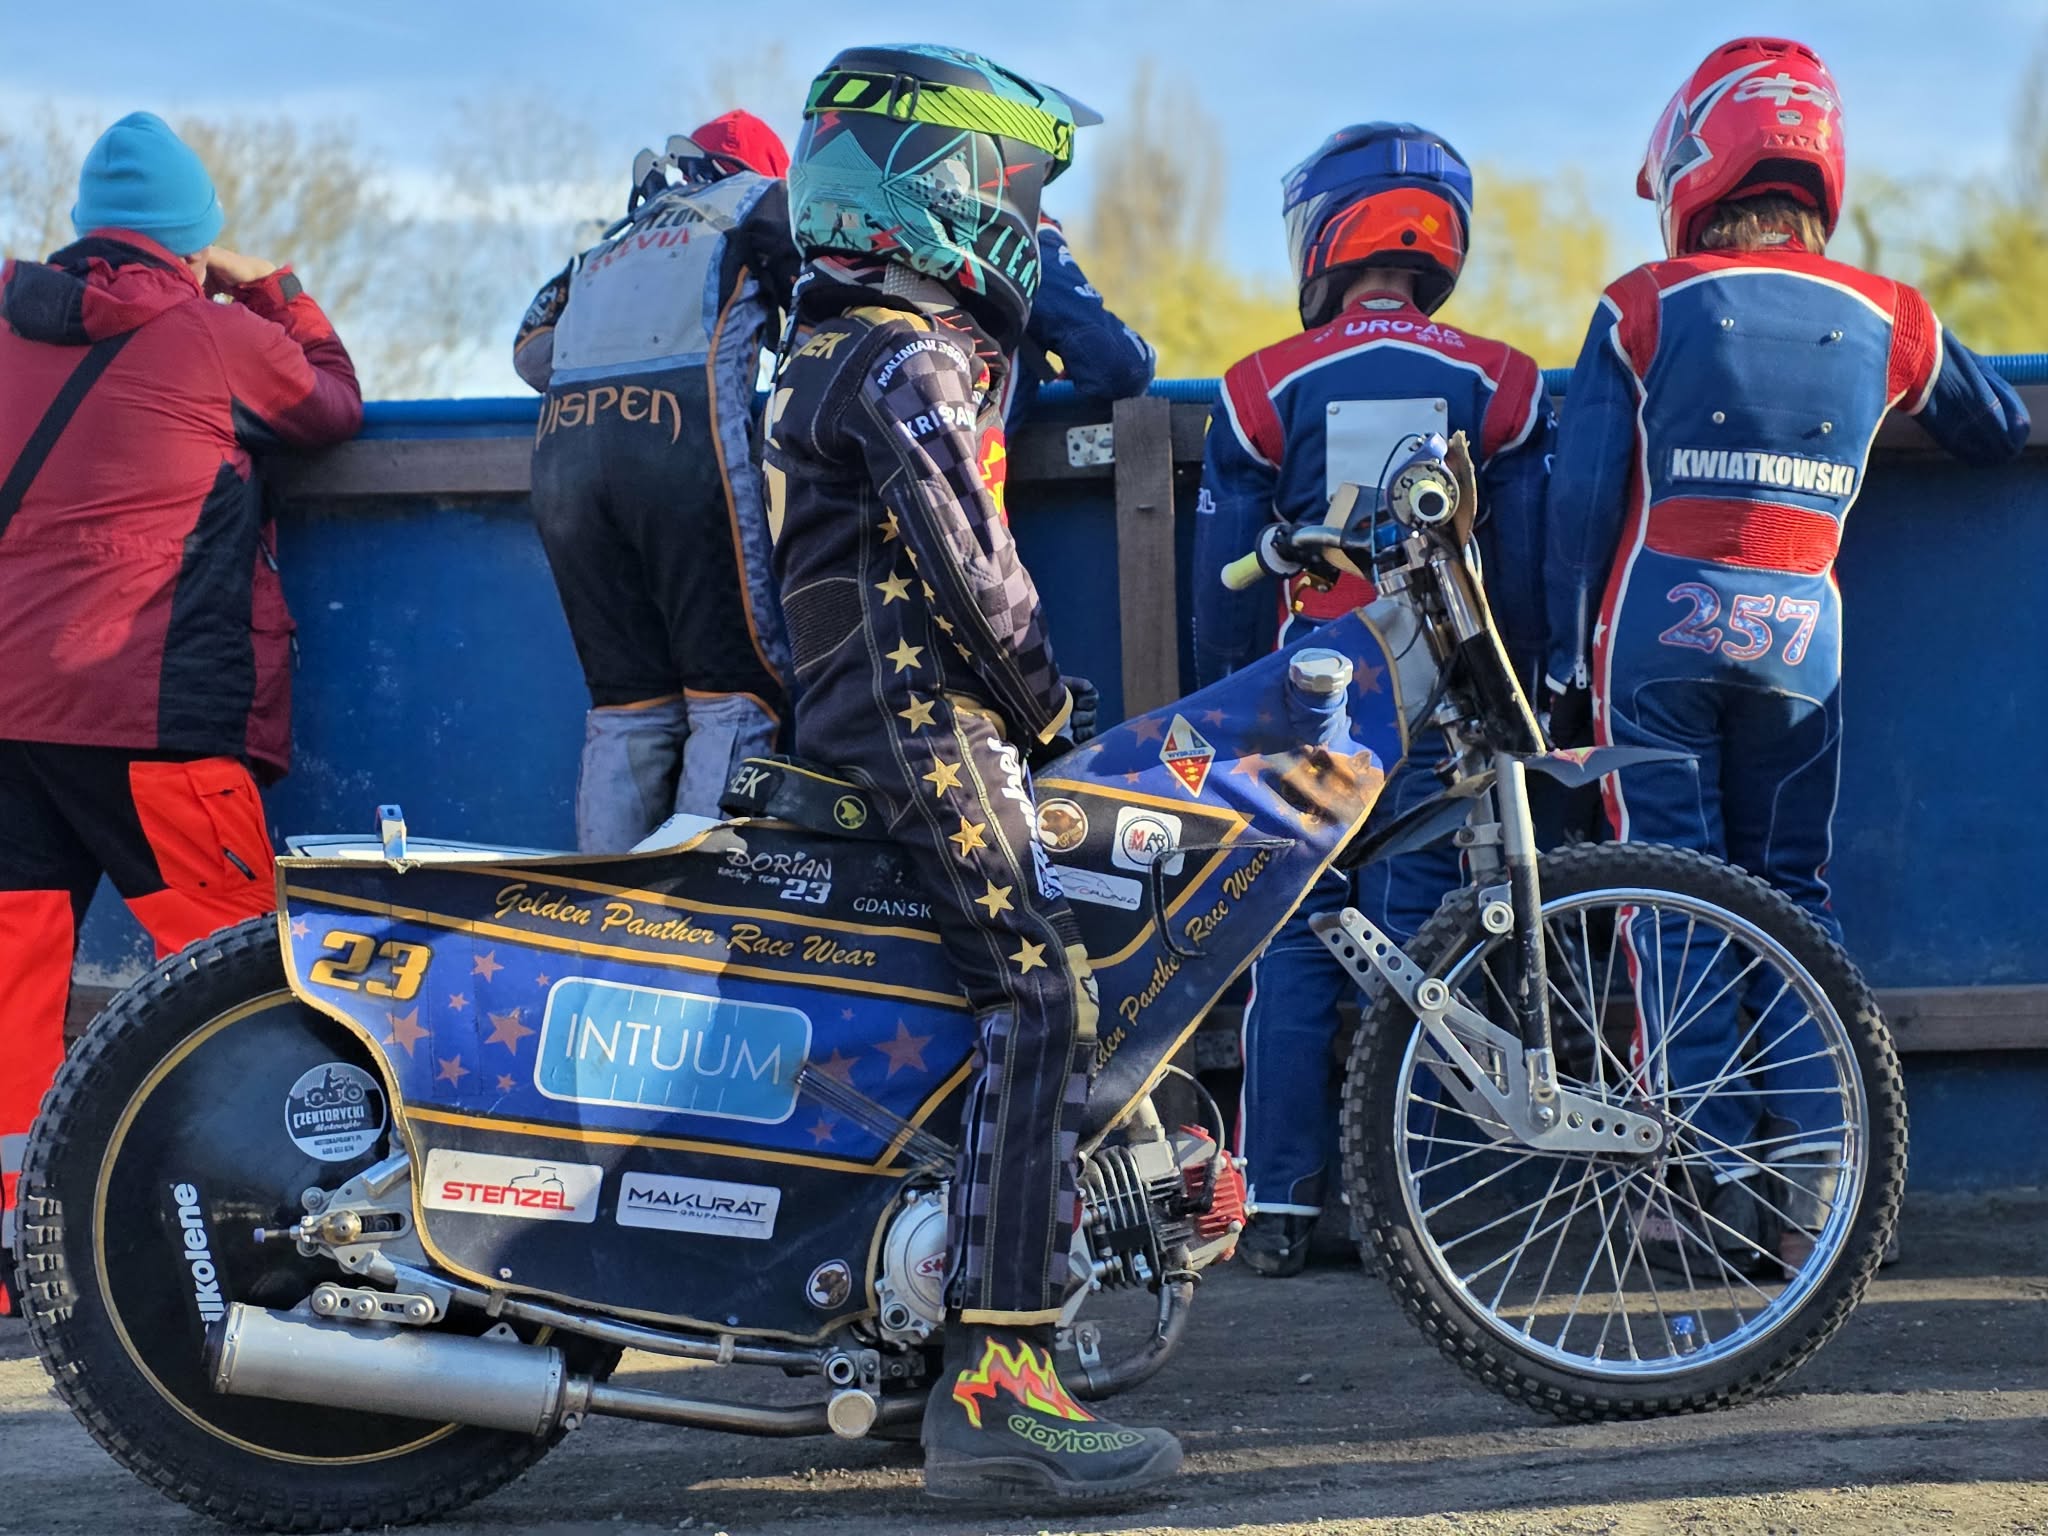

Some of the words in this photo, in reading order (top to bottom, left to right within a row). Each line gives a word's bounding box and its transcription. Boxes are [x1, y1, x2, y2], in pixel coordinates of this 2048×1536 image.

[1672, 447, 1856, 496] KWIATKOWSKI
[1658, 582, 1820, 666] 257
[780, 878, 832, 904] 23
[495, 883, 591, 925] Golden
[600, 902, 716, 945] Panther
[726, 923, 793, 957] Race
[803, 935, 877, 967] Wear
[1119, 952, 1184, 1027] Panthe
[1185, 901, 1229, 947] Race
[1223, 850, 1270, 900] Wear
[309, 930, 432, 1000] 23
[565, 1013, 781, 1085] INTUUM
[628, 1187, 768, 1217] MAKURAT
[680, 1209, 718, 1220] GRUPA
[1008, 1415, 1145, 1452] daytona
